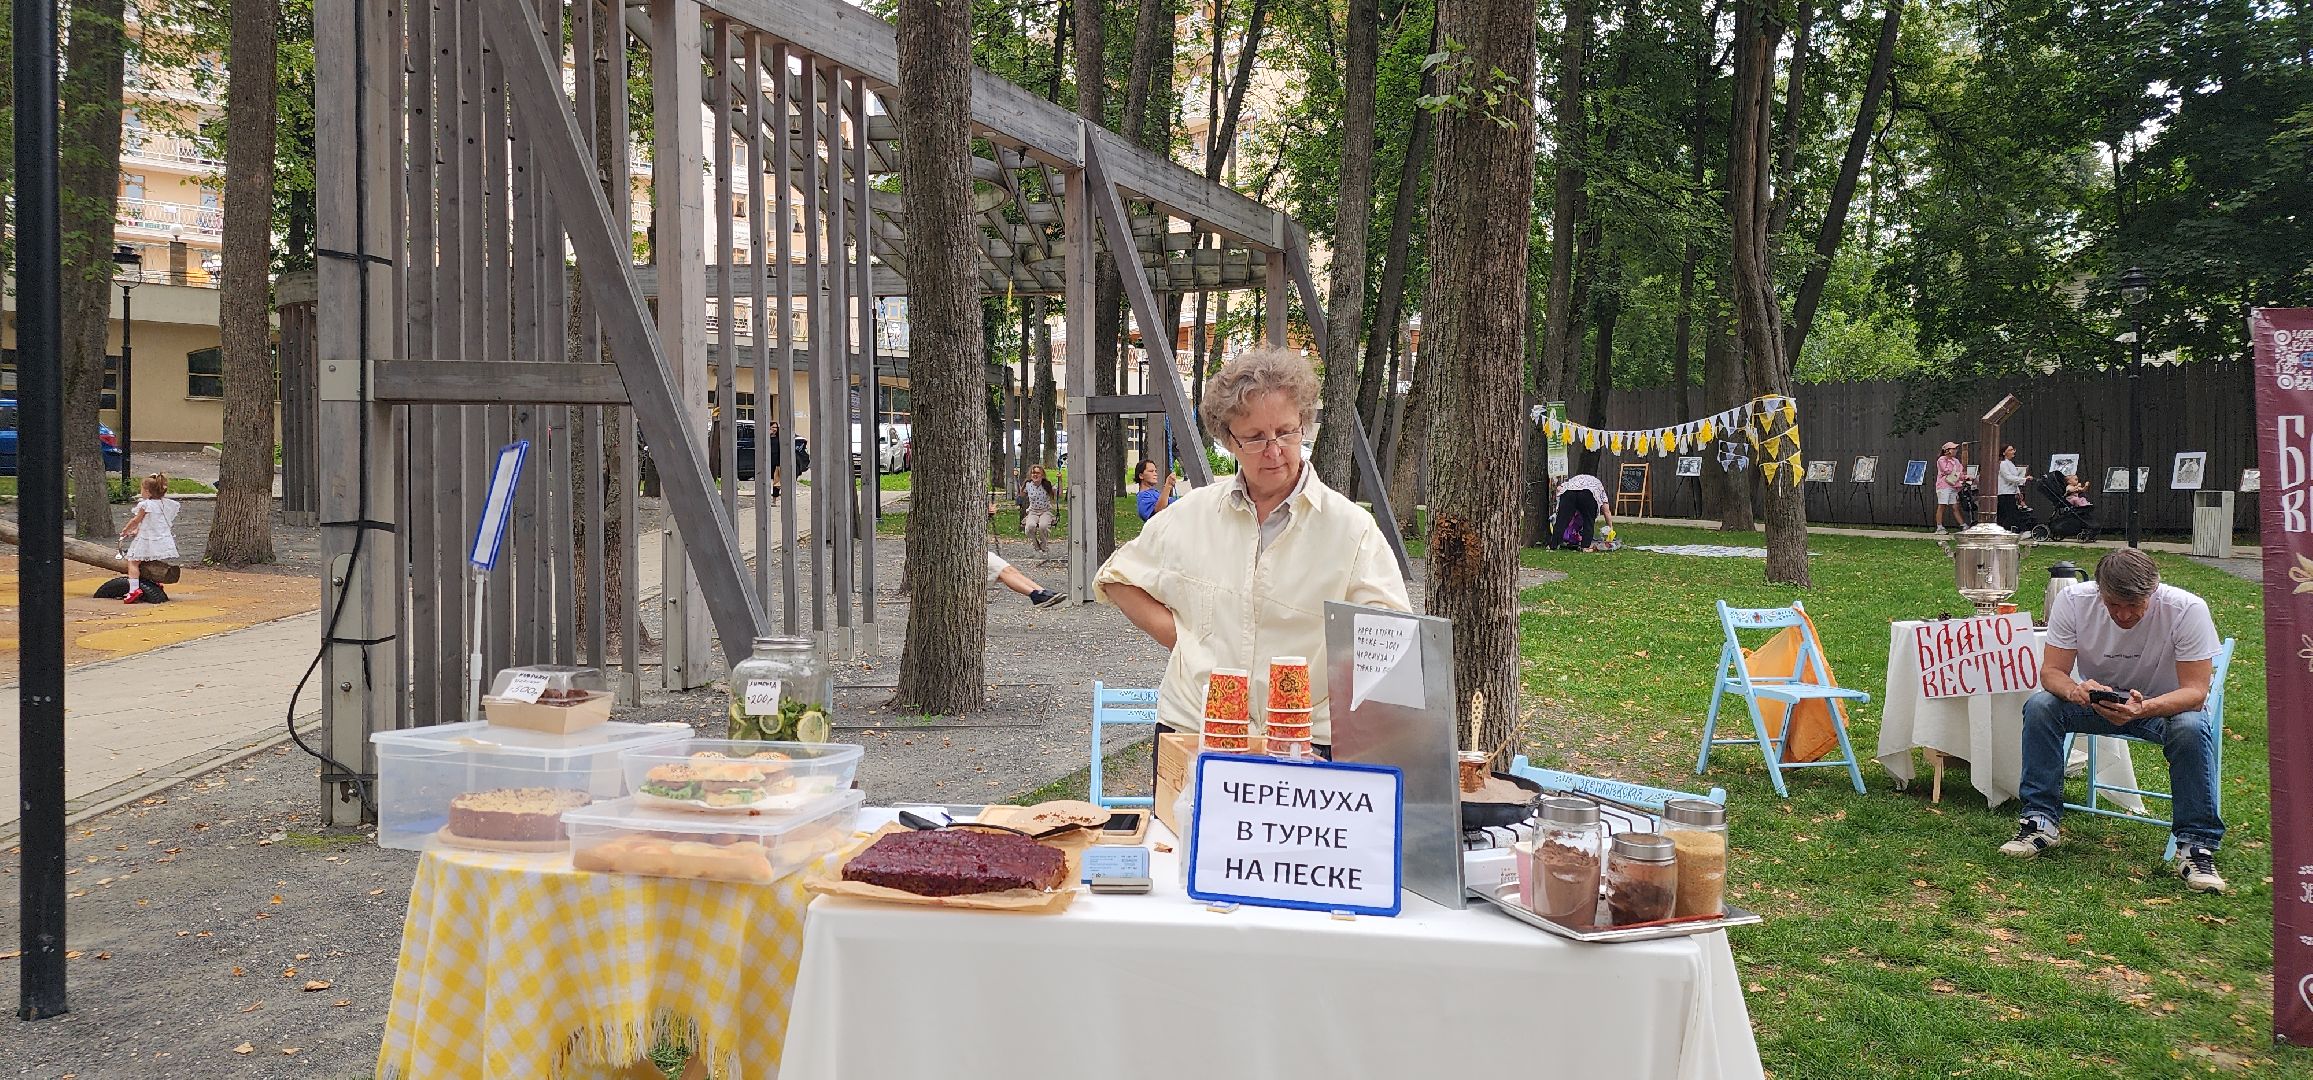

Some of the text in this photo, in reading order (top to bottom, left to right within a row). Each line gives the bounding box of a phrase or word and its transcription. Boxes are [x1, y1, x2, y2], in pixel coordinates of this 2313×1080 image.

[2278, 415, 2313, 490] Б
[2281, 489, 2313, 532] В
[1916, 617, 2028, 672] БЛАГО-
[1922, 645, 2038, 698] ВЕСТНО
[1222, 780, 1374, 813] ЧЕРЁМУХА
[1236, 820, 1348, 849] В ТУРКЕ
[1225, 857, 1363, 891] НА ПЕСКЕ
